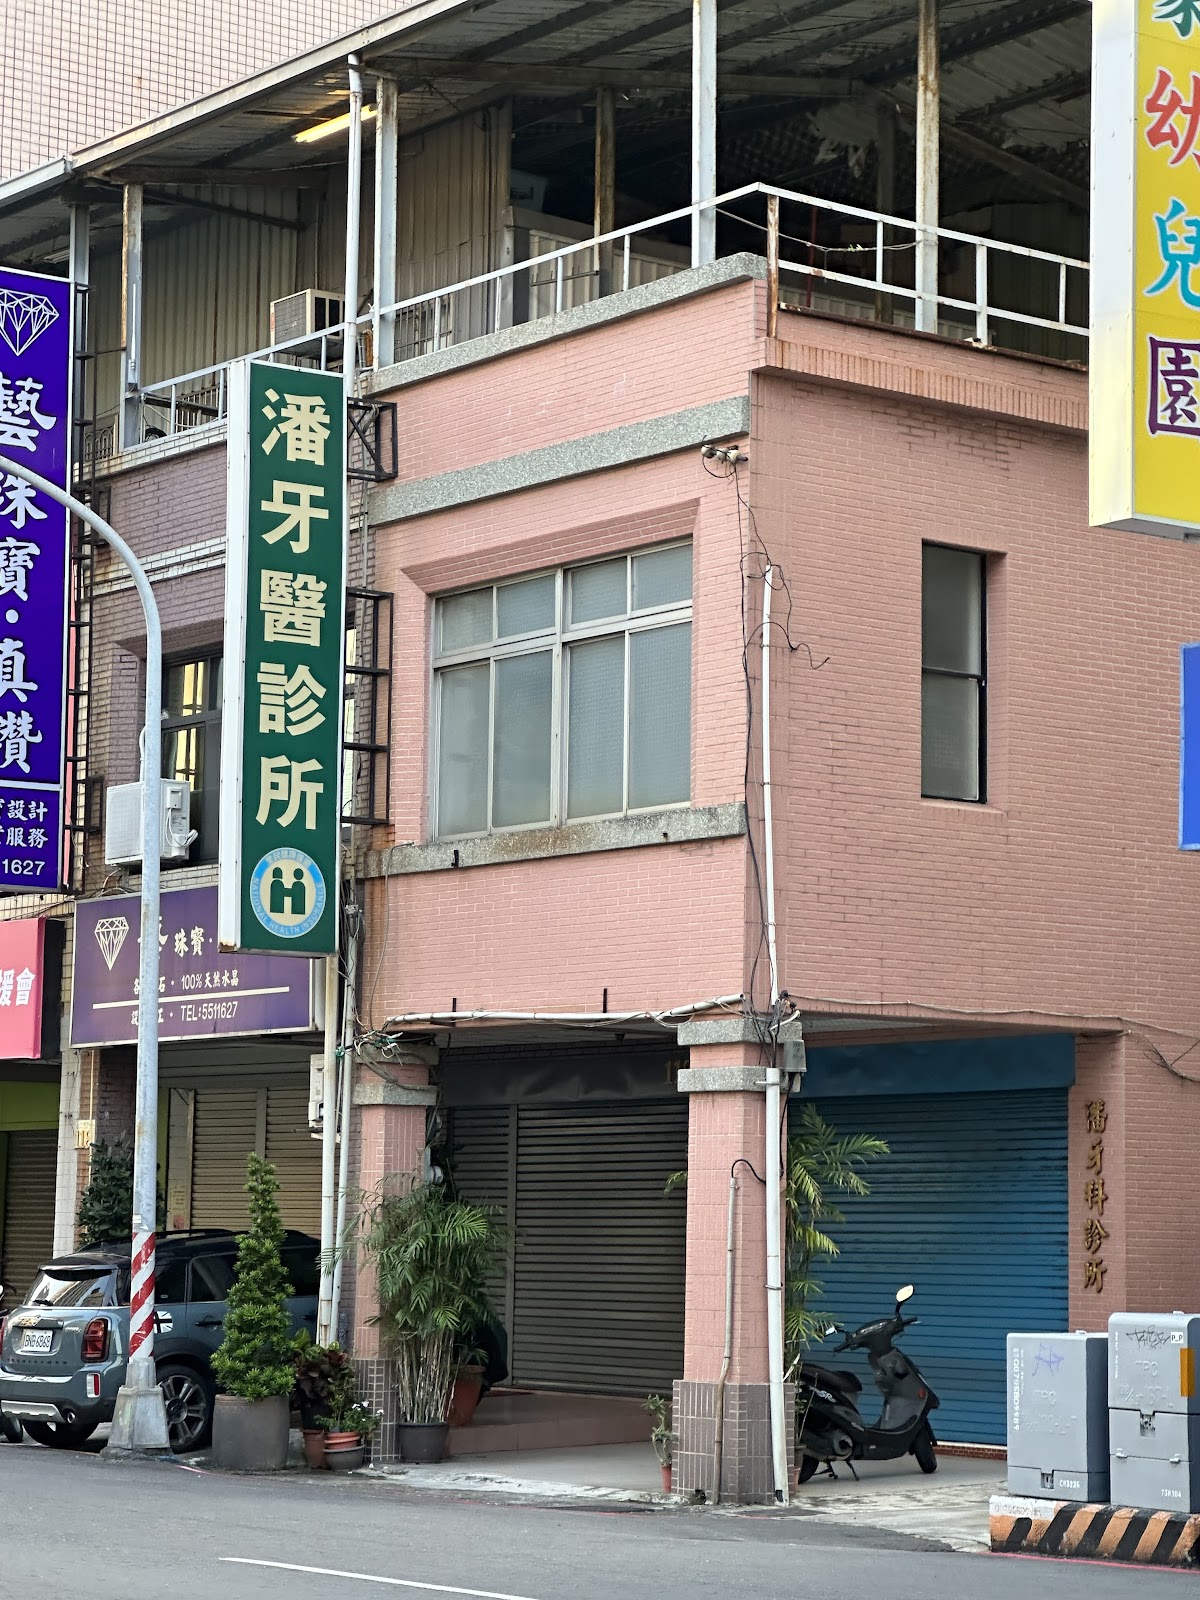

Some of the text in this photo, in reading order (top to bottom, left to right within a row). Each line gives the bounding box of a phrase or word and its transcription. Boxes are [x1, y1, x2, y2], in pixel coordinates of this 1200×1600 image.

[256, 388, 331, 831] 潘牙醫診所
[0, 798, 48, 822] 設計
[0, 825, 48, 849] 服務
[2, 859, 46, 876] 1627
[269, 920, 300, 935] HEALTH
[1083, 1098, 1110, 1294] 潘牙科診所
